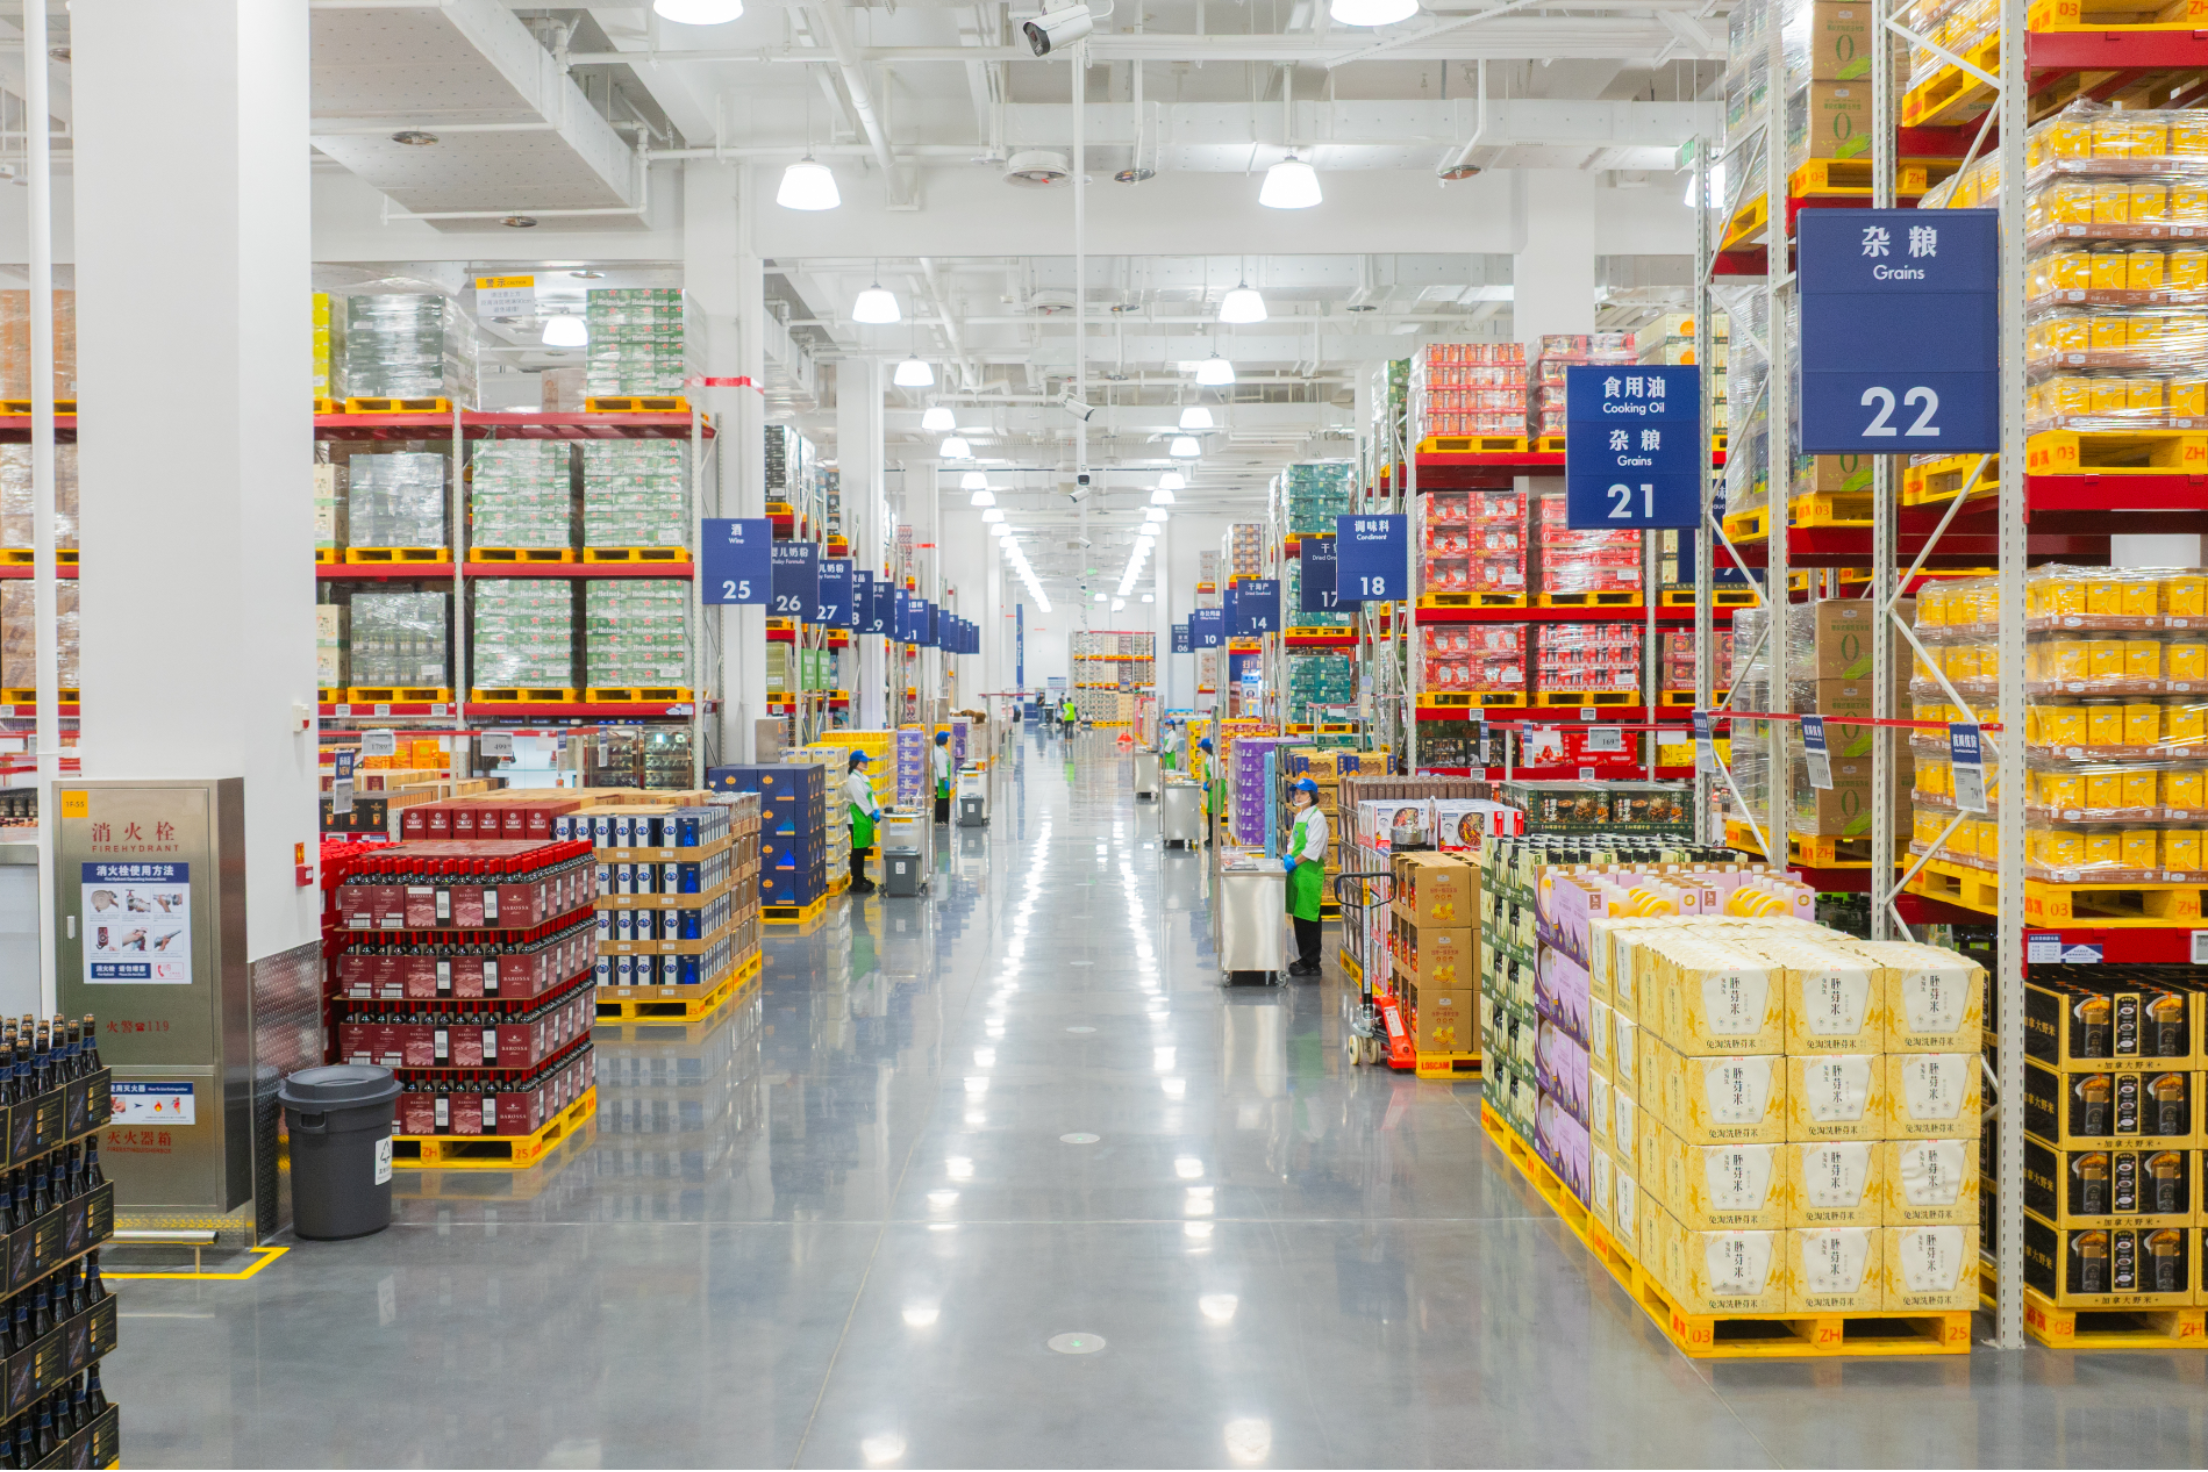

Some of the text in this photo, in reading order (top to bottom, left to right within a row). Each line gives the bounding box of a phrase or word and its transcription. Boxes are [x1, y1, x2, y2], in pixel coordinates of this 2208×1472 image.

[2058, 3, 2078, 16] 03
[1811, 171, 1826, 182] 03
[1909, 172, 1925, 184] ZH
[1861, 225, 1938, 258] 杂粮
[1873, 264, 1926, 282] Grains
[1602, 375, 1666, 400] 食用油
[1602, 402, 1665, 416] Cooking Oil
[1860, 385, 1940, 438] 22
[1608, 429, 1661, 453] 杂粮
[2057, 446, 2076, 460] 03
[2184, 446, 2206, 460] ZH
[1616, 455, 1653, 467] Grains
[1607, 483, 1654, 518] 21
[1815, 505, 1830, 516] 03
[731, 523, 743, 536] 酒
[1355, 519, 1390, 533] 调味料
[728, 537, 745, 545] Wine
[1356, 533, 1387, 541] Condiment
[819, 563, 844, 574] 儿奶粉
[722, 580, 751, 600] 25
[1360, 576, 1386, 596] 18
[776, 595, 801, 612] 26
[816, 604, 838, 620] 27
[1251, 616, 1267, 630] 14
[1204, 634, 1217, 645] 10
[1177, 644, 1189, 653] 06
[92, 821, 175, 843] 消火栓
[92, 845, 179, 853] FIREHYDRANT
[1816, 847, 1834, 859] ZH
[96, 864, 174, 877] 消火栓使用方法
[2050, 903, 2069, 917] 03
[2177, 901, 2199, 915] ZH
[106, 1020, 169, 1033] 火警 119
[1421, 1062, 1450, 1071] LOSCAM
[2105, 1061, 2154, 1070] 加拿大野米
[107, 1130, 171, 1146] 灭火器箱
[2104, 1140, 2154, 1148] 加拿大野米
[422, 1147, 438, 1158] ZH
[514, 1149, 529, 1159] 25
[2103, 1218, 2154, 1227] 加拿大野米
[2101, 1296, 2152, 1305] 加拿大野米
[1819, 1328, 1841, 1342] ZH
[1949, 1327, 1968, 1341] 25
[2054, 1321, 2073, 1335] 03
[2181, 1322, 2203, 1337] ZH
[1692, 1329, 1711, 1343] 03
